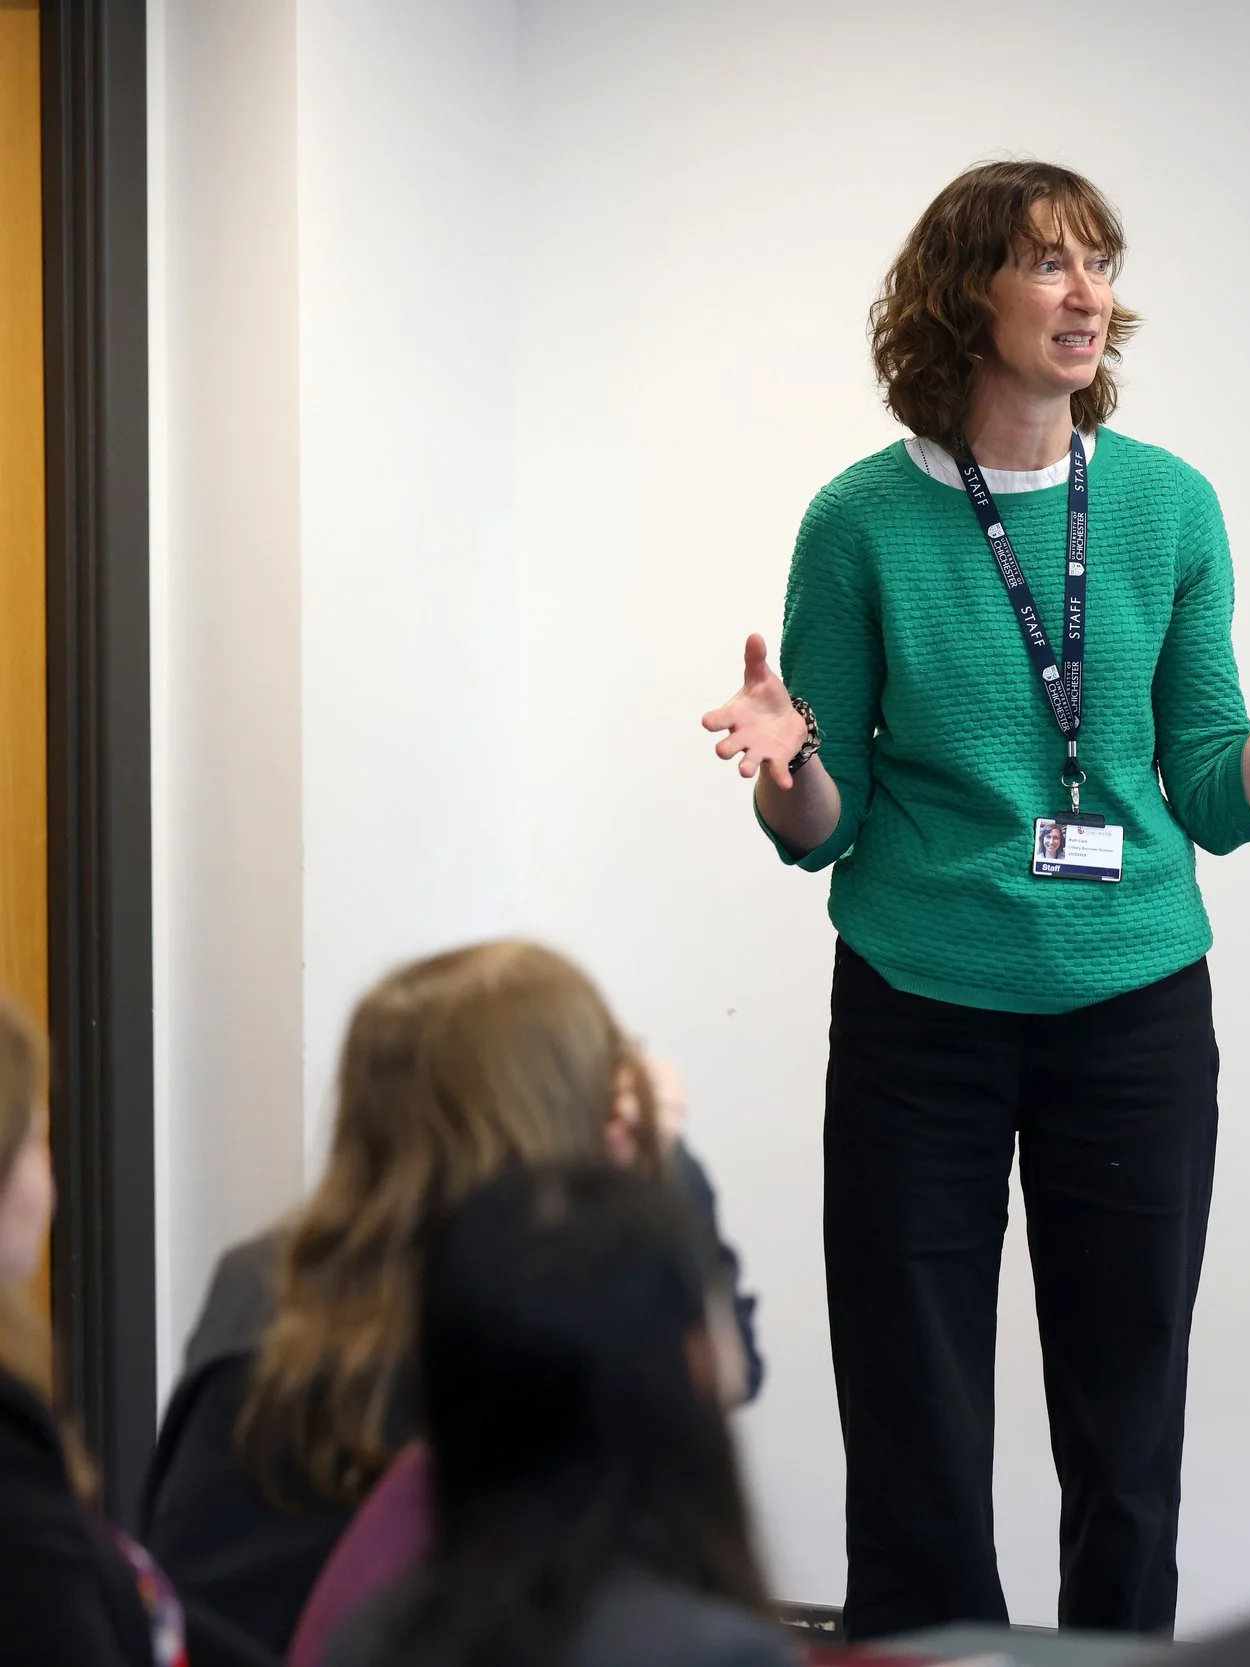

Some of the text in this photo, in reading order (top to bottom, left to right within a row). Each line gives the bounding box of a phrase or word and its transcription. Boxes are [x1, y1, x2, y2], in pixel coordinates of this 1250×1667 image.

[964, 467, 989, 506] STAFF
[1074, 451, 1084, 492] STAFF
[1000, 538, 1018, 576] UNIVERSITY
[1076, 512, 1085, 561] CHICHESTER
[993, 540, 1018, 588] CHICHESTER
[1020, 605, 1046, 647] STAFF
[1069, 597, 1081, 639] STAFF
[1048, 683, 1070, 732] CHICHESTER
[1055, 681, 1071, 720] UNIVERSITY
[1042, 863, 1061, 872] Staff
